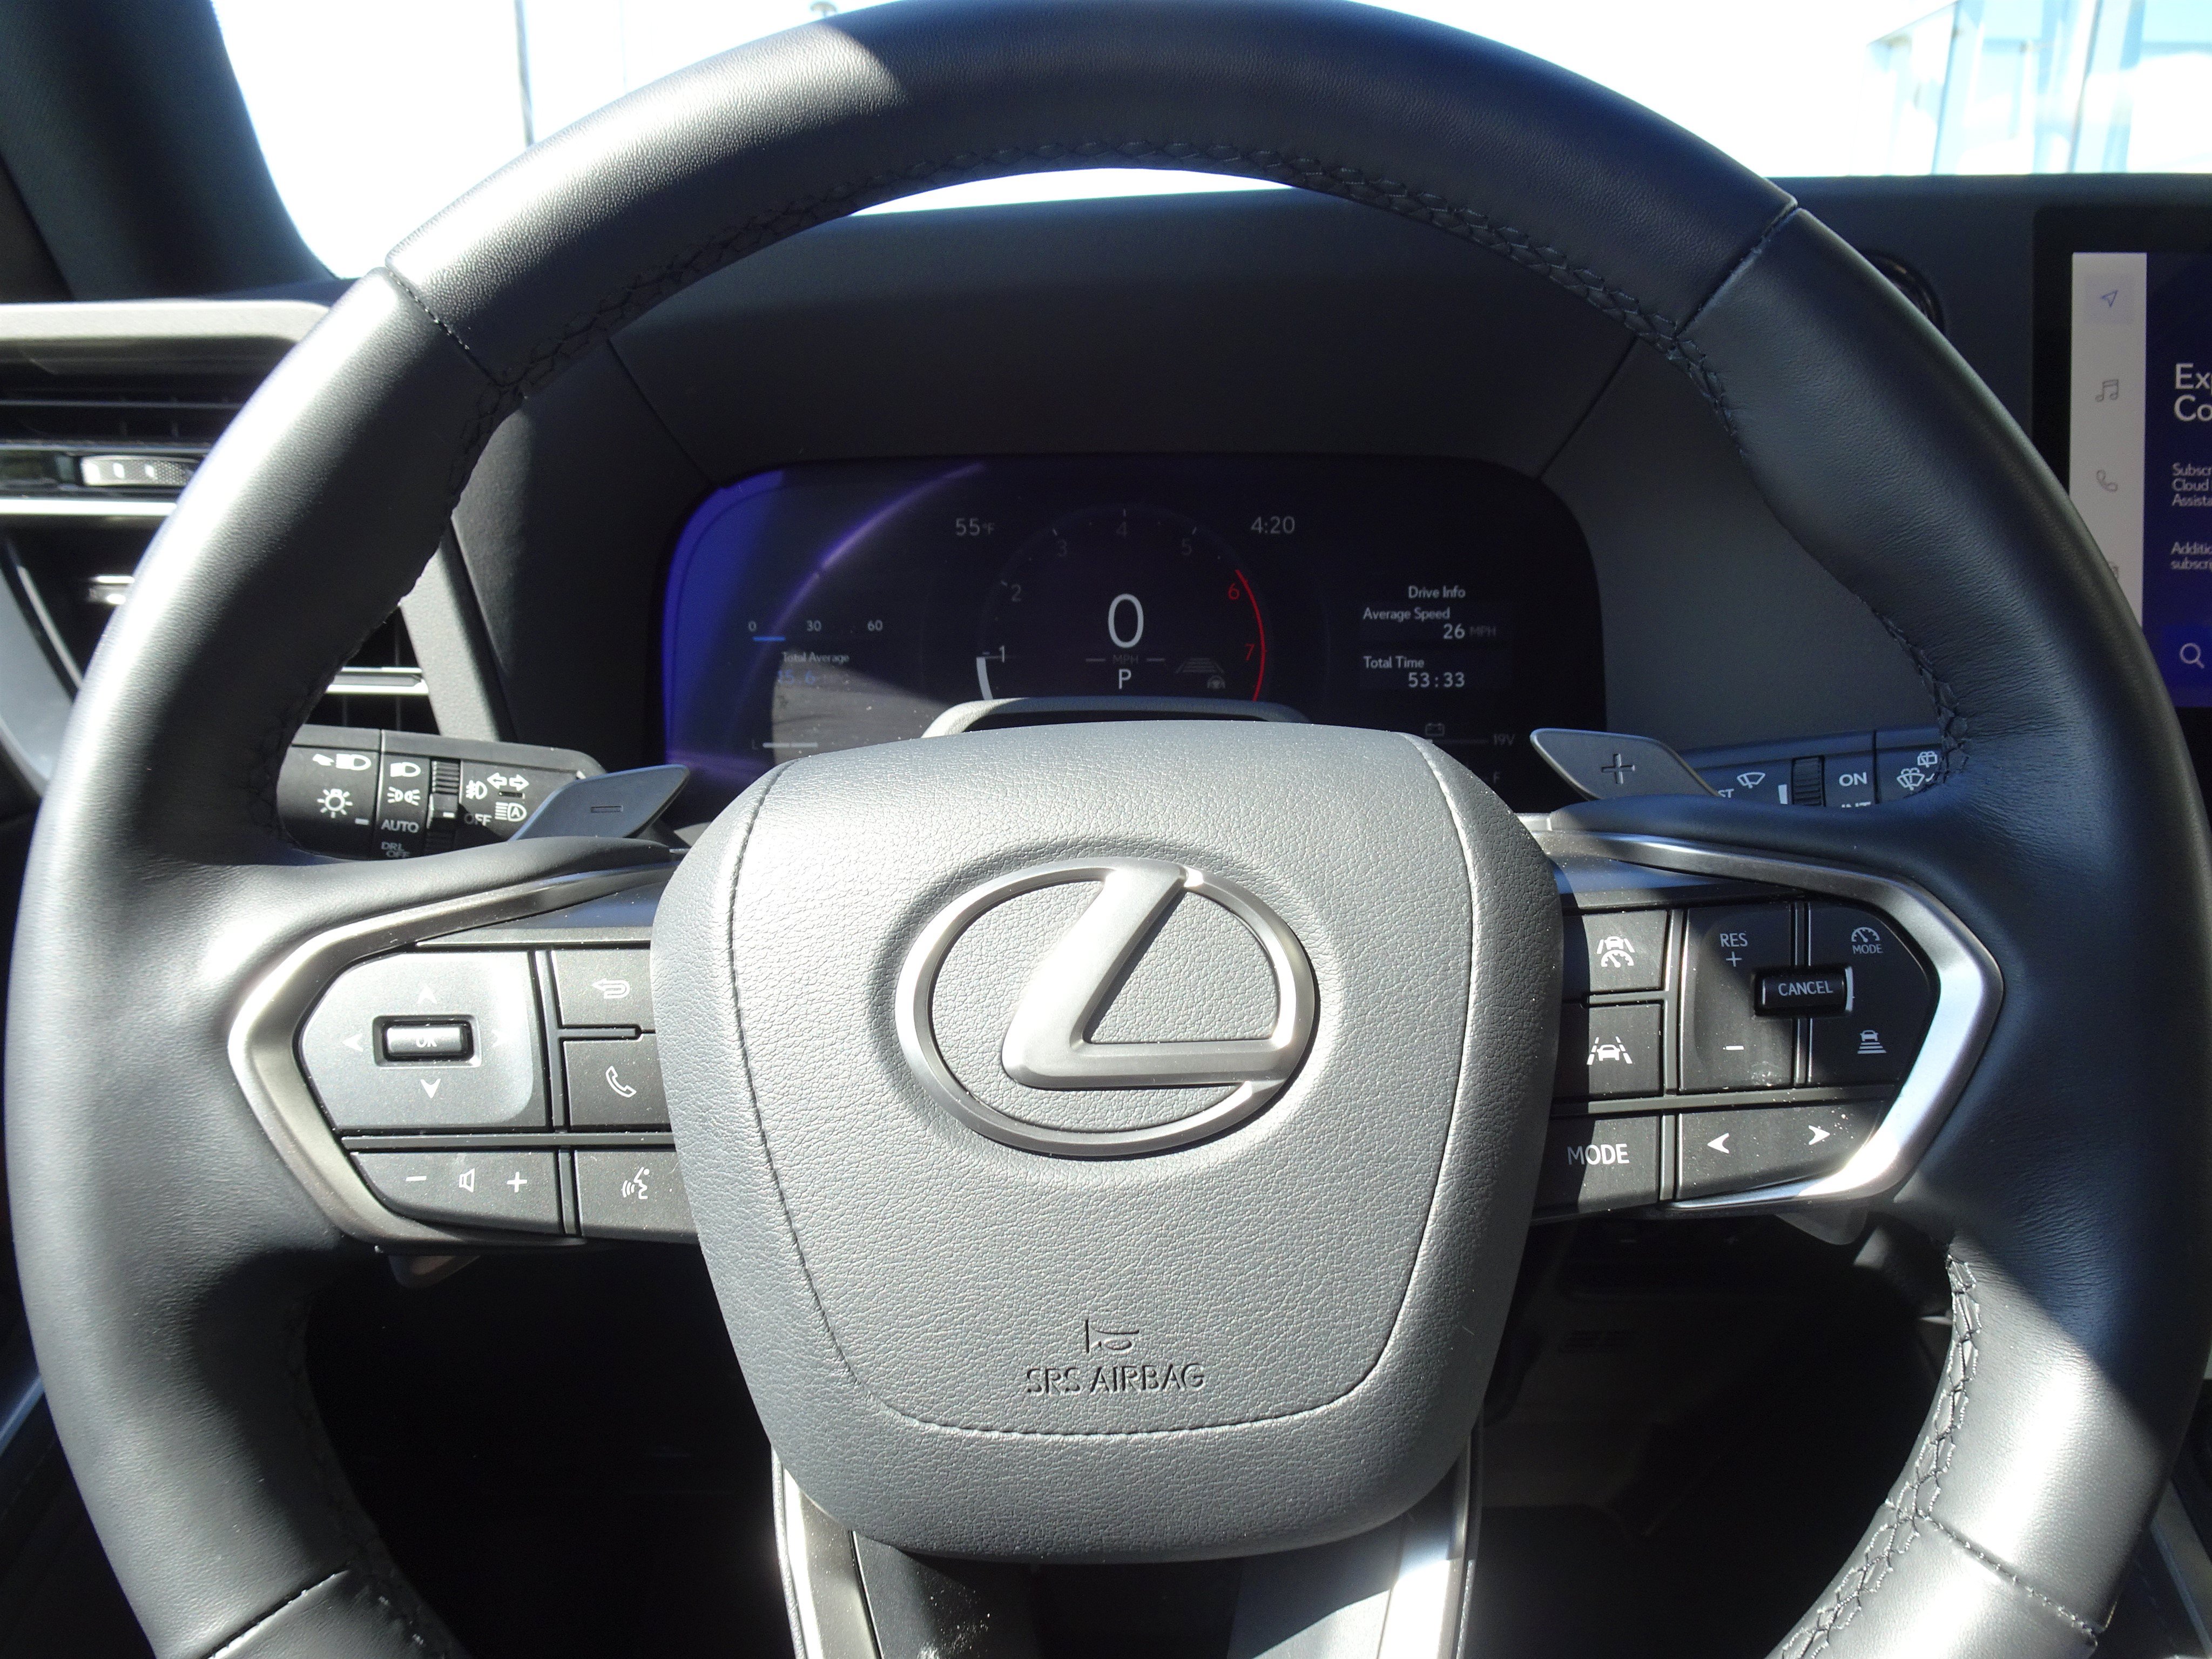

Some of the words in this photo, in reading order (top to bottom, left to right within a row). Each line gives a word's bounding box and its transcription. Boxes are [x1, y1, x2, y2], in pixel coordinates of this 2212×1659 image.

[2171, 477, 2210, 492] Cloud
[1250, 516, 1296, 535] 4:20
[1011, 583, 1022, 602] 2
[1226, 582, 1241, 601] 6
[1407, 585, 1440, 599] Drive
[1442, 585, 1466, 599] Info
[1108, 593, 1144, 649] 0
[1363, 606, 1412, 623] Average
[1413, 606, 1451, 622] Speed
[748, 620, 757, 632] 0
[806, 619, 822, 632] 30
[867, 619, 884, 632] 60
[1442, 623, 1466, 640] 26
[1469, 625, 1497, 638] MPH
[781, 651, 807, 663] Total
[808, 651, 849, 665] Average
[1112, 654, 1139, 665] MPH
[1244, 643, 1256, 662] 7
[1363, 655, 1392, 669] Total
[1395, 655, 1425, 669] Time
[1118, 668, 1132, 690] P
[1408, 671, 1466, 689] 53:33
[1838, 771, 1868, 787] ON
[381, 819, 420, 833] AUTO
[463, 812, 493, 826] OFF
[381, 841, 406, 852] DRL
[385, 850, 410, 859] OFF
[1719, 932, 1749, 948] RES
[1852, 943, 1883, 955] MODE
[1777, 980, 1834, 997] CANCEL
[415, 1035, 437, 1048] OK
[1567, 1143, 1630, 1166] MODE
[1026, 1367, 1081, 1394] SRS
[1089, 1363, 1205, 1394] AIRBAG
